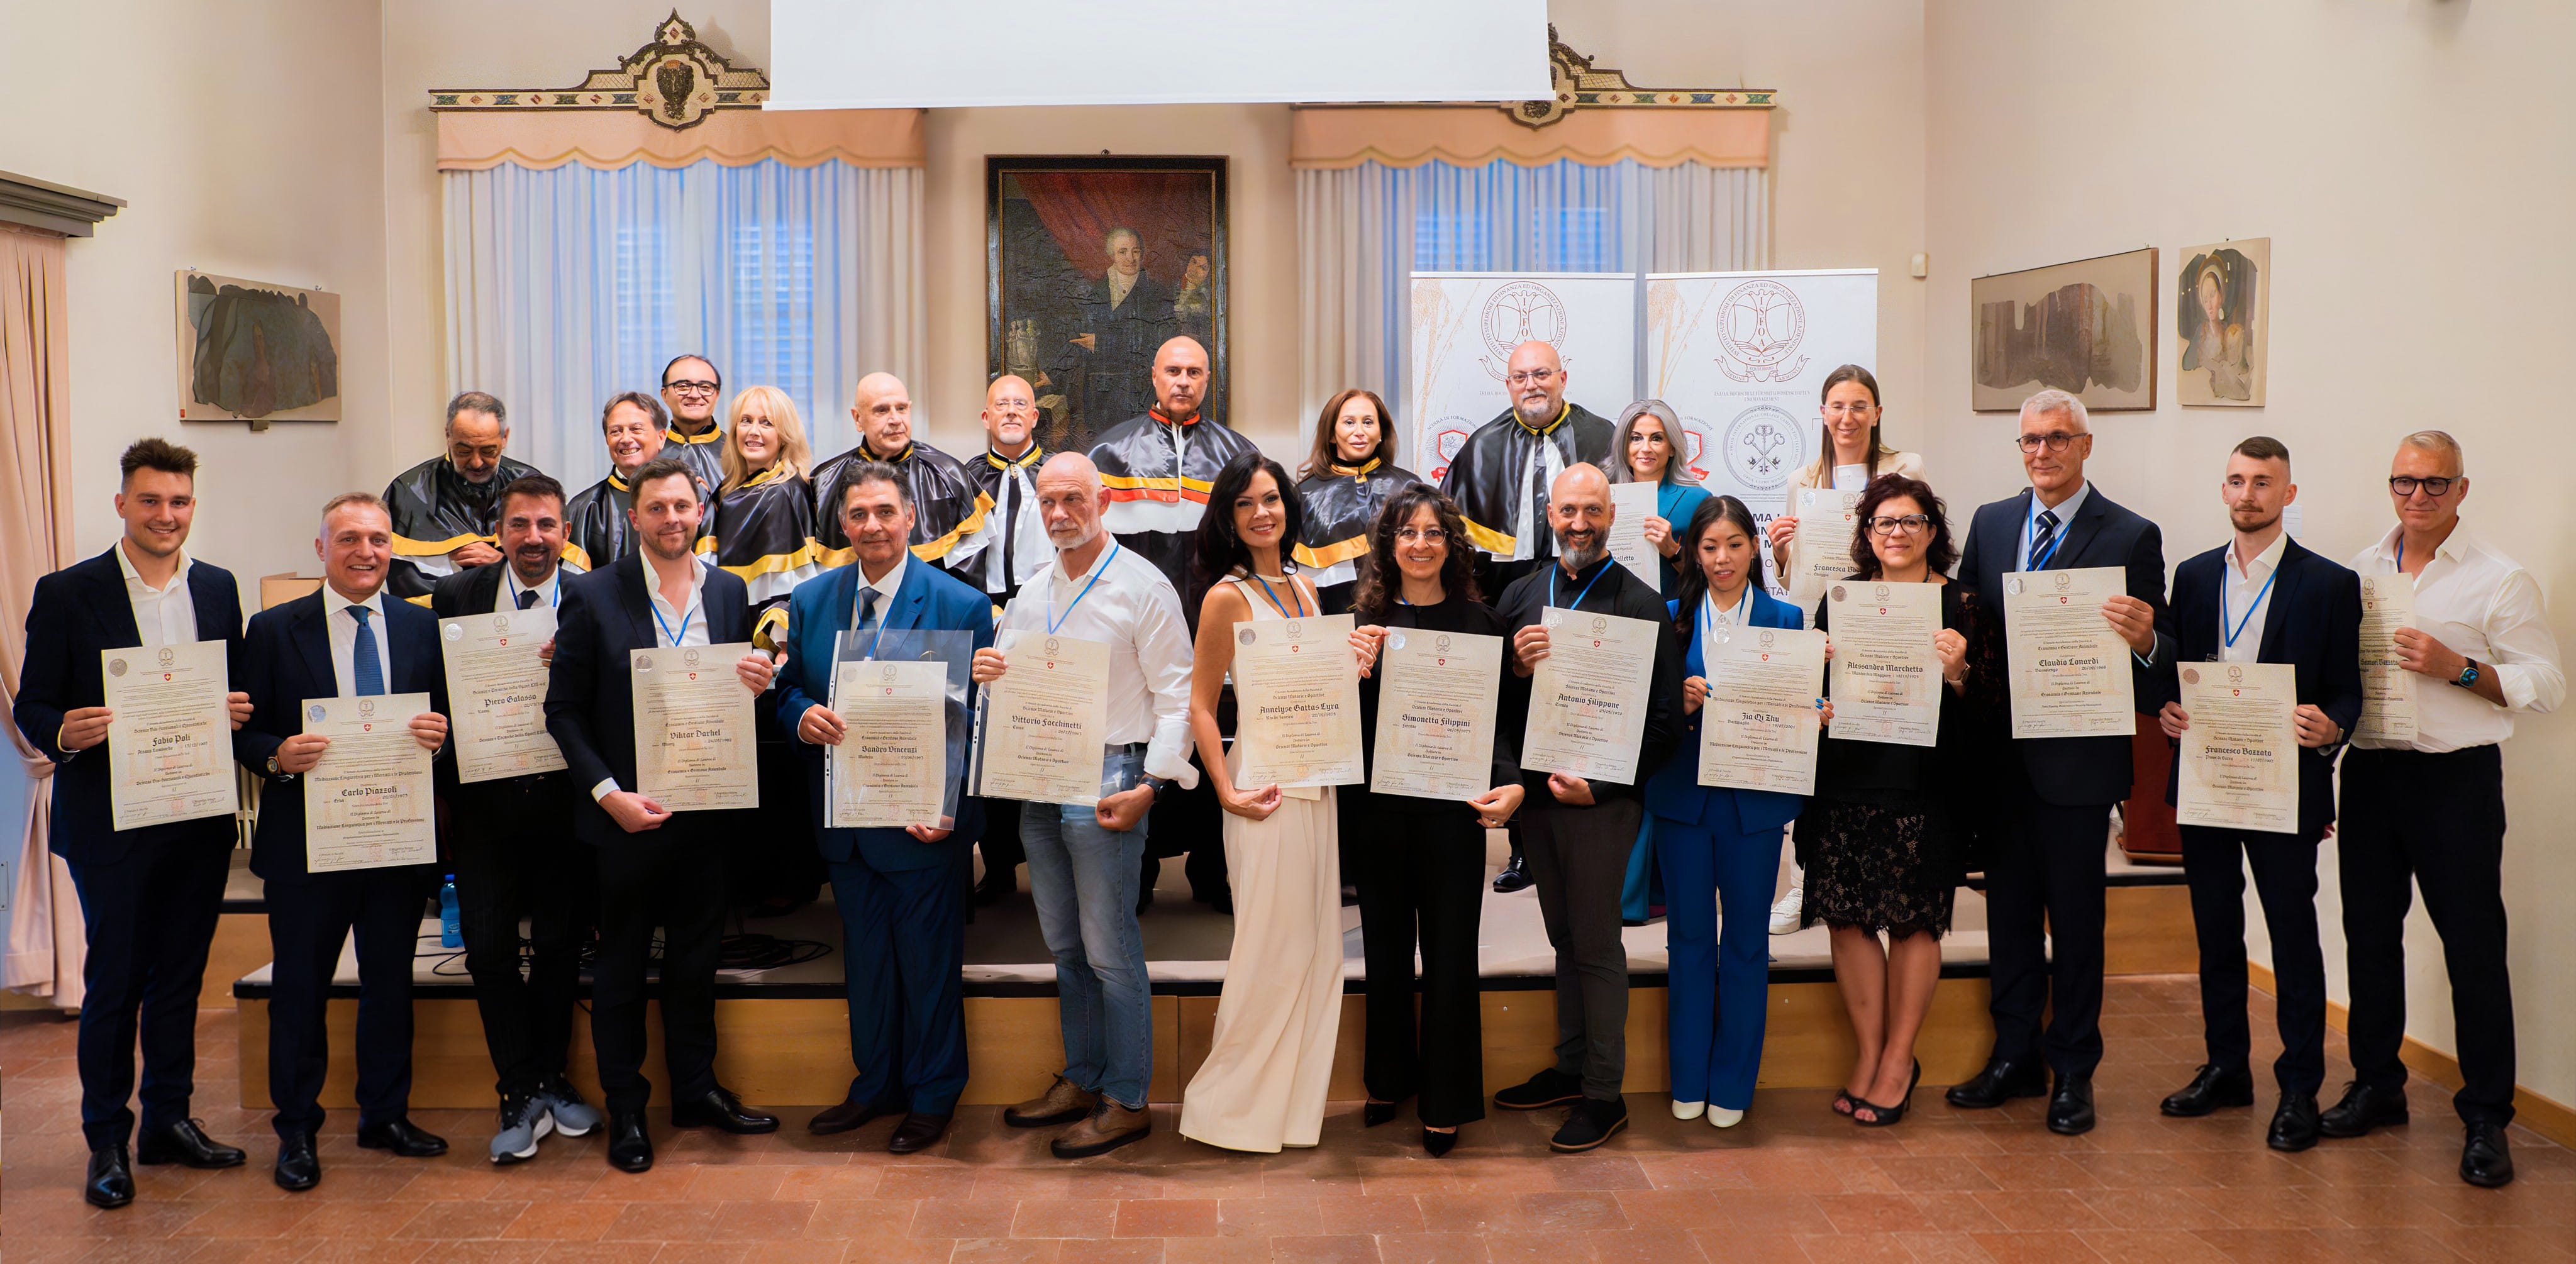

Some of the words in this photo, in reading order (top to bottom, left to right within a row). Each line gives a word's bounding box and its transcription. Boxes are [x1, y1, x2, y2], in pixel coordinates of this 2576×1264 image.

[1734, 283, 1758, 297] FINANZA
[1484, 302, 1494, 333] SUPERIORE
[1499, 283, 1521, 297] FINANZA
[1531, 285, 1564, 325] ORGANIZZAZIONE
[1769, 284, 1803, 323] ORGANIZZAZIONE
[1719, 303, 1730, 333] SUPERIORE
[1785, 324, 1803, 354] AZIENDALE
[1491, 370, 1505, 380] ORDIN
[1726, 371, 1745, 381] ORDINE
[1779, 367, 1801, 380] ARMONIA
[1428, 418, 1444, 430] SCUOLA
[1684, 416, 1713, 431] FORMAZIONE
[1814, 564, 1846, 572] Francesca
[1847, 662, 1884, 672] Alessandra
[2068, 657, 2099, 665] Lonardi
[484, 699, 506, 707] Piero
[507, 694, 536, 703] Galasso
[1557, 693, 1585, 704] Antonio
[1587, 697, 1619, 709] Filippone
[1259, 705, 1292, 715] Annelyse
[1321, 703, 1339, 711] Lyra
[1012, 715, 1040, 725] Vittorio
[1041, 719, 1082, 729] Facchinetti
[1402, 714, 1439, 724] Simonetta
[1440, 718, 1470, 727] Filippini
[1742, 712, 1753, 721] Jia
[1755, 714, 1764, 723] Qi
[1766, 714, 1779, 723] Zhu
[153, 737, 173, 746] Fabio
[175, 734, 190, 743] Poli
[862, 745, 887, 753] Sandro
[2206, 745, 2241, 755] Francesco
[2243, 748, 2272, 757] Bozzato
[342, 788, 364, 797] Carlo
[365, 786, 397, 796] Piazzoli
